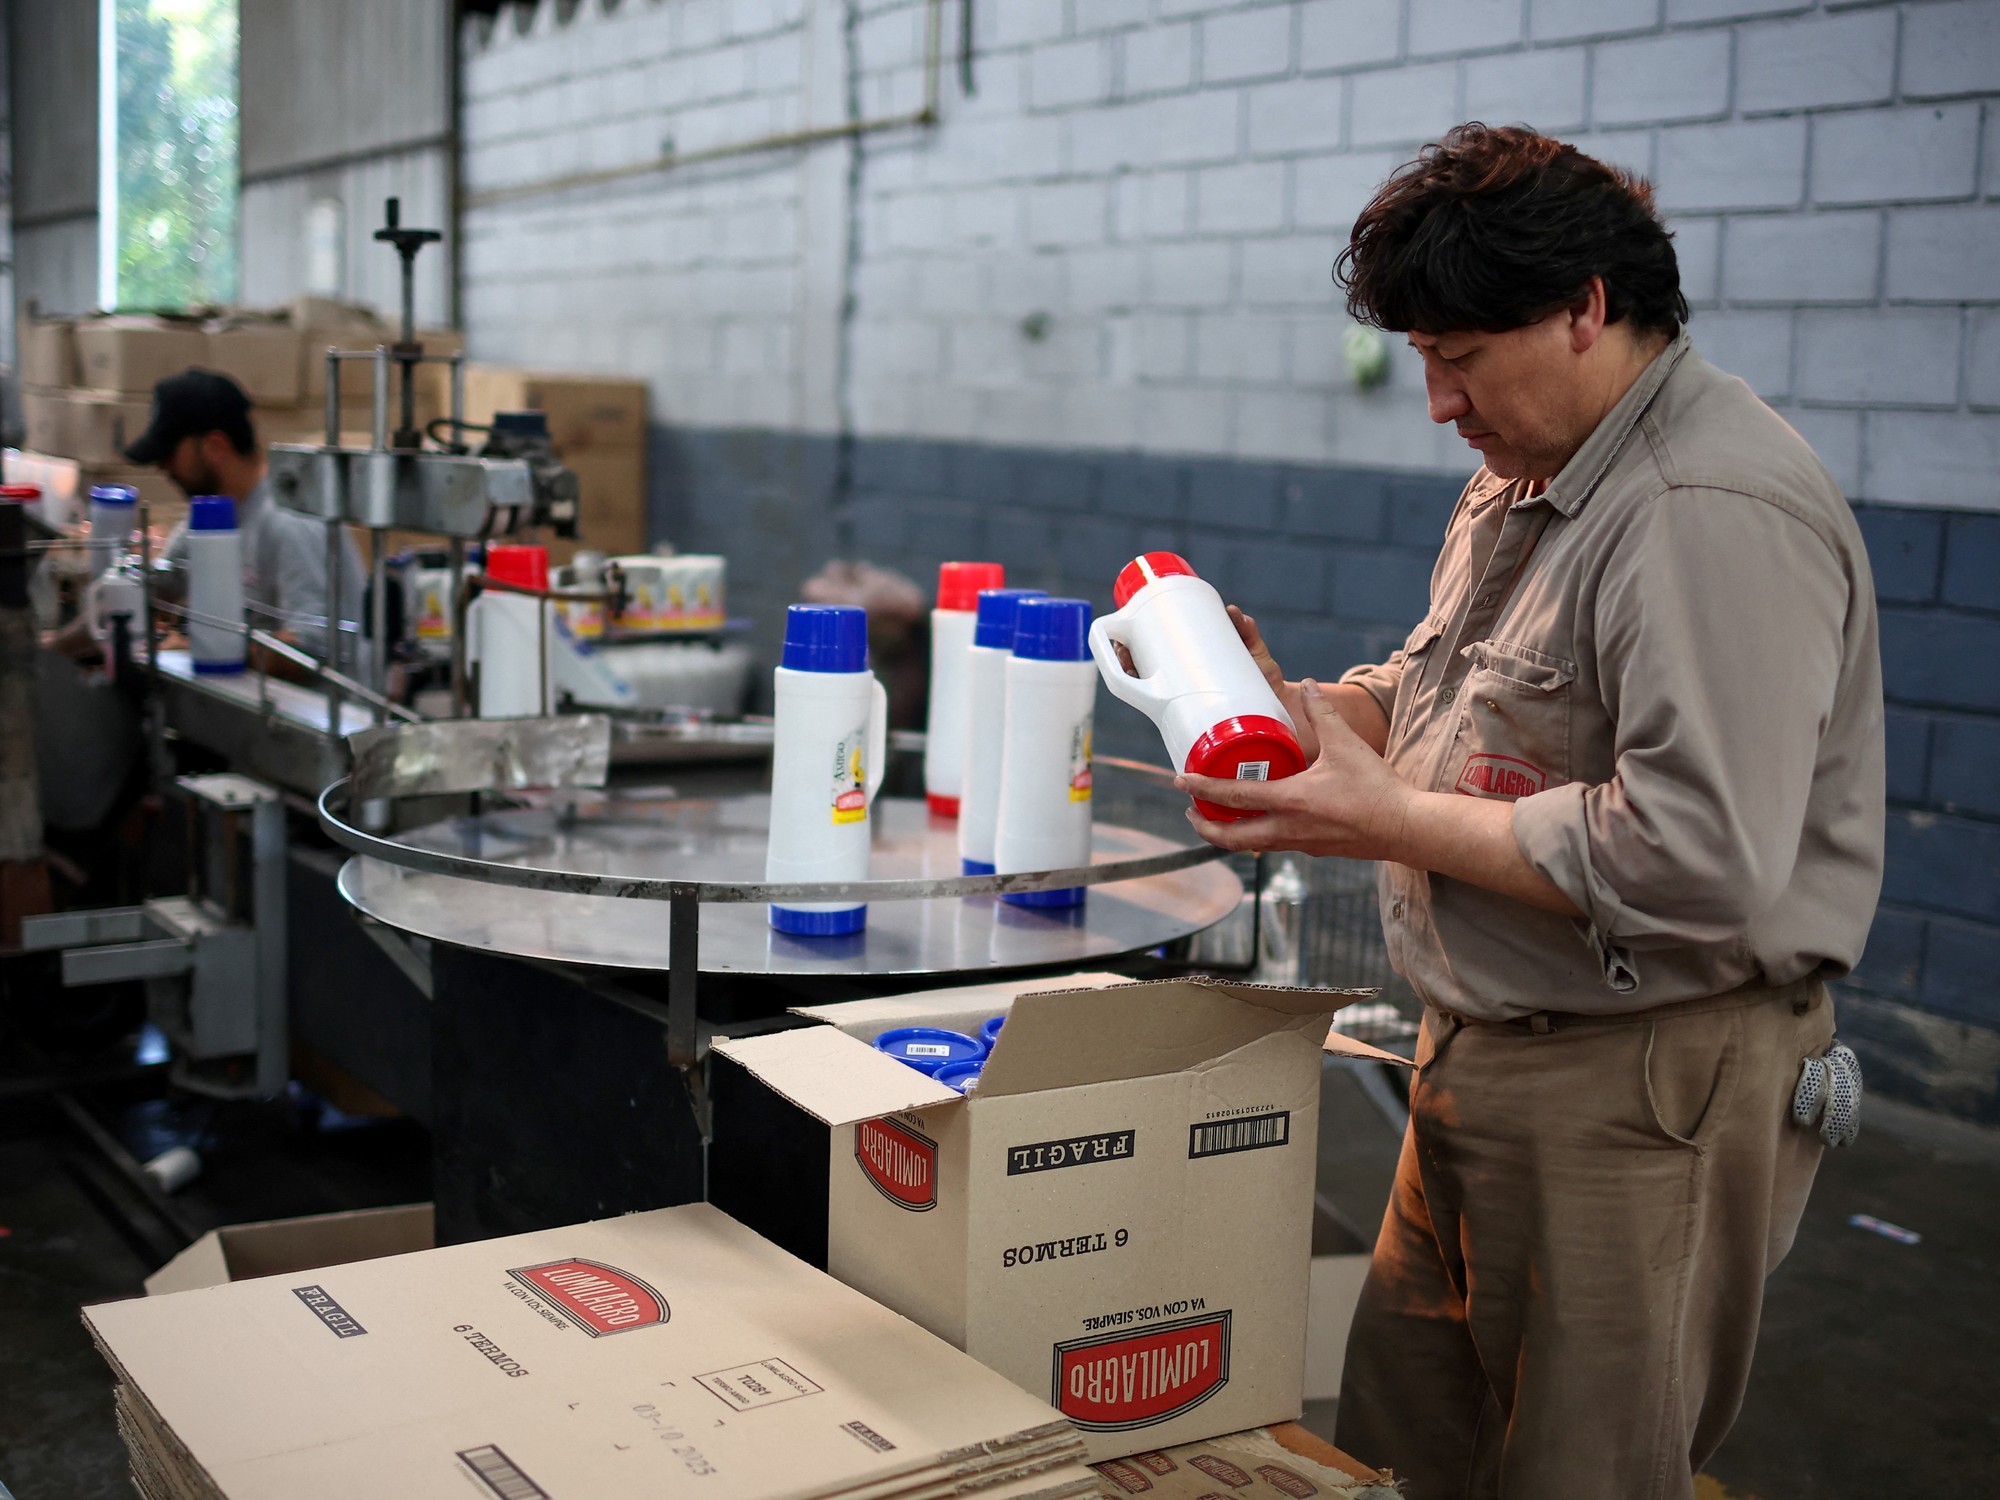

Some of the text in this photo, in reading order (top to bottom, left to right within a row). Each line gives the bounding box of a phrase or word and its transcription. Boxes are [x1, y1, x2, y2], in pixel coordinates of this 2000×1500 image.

[862, 1124, 927, 1187] LUMILAGRO
[1013, 1134, 1129, 1170] FRAGIL
[1003, 1228, 1129, 1268] 6 TERMOS
[299, 1287, 359, 1336] FRAGIL
[542, 1267, 641, 1326] LUMILAGRO
[1082, 1297, 1206, 1331] VA CON VOS. SIEMPRE.
[452, 1323, 530, 1378] 6 TERMOS
[1070, 1338, 1209, 1404] LUMILAGRO
[737, 1374, 772, 1396] T0281
